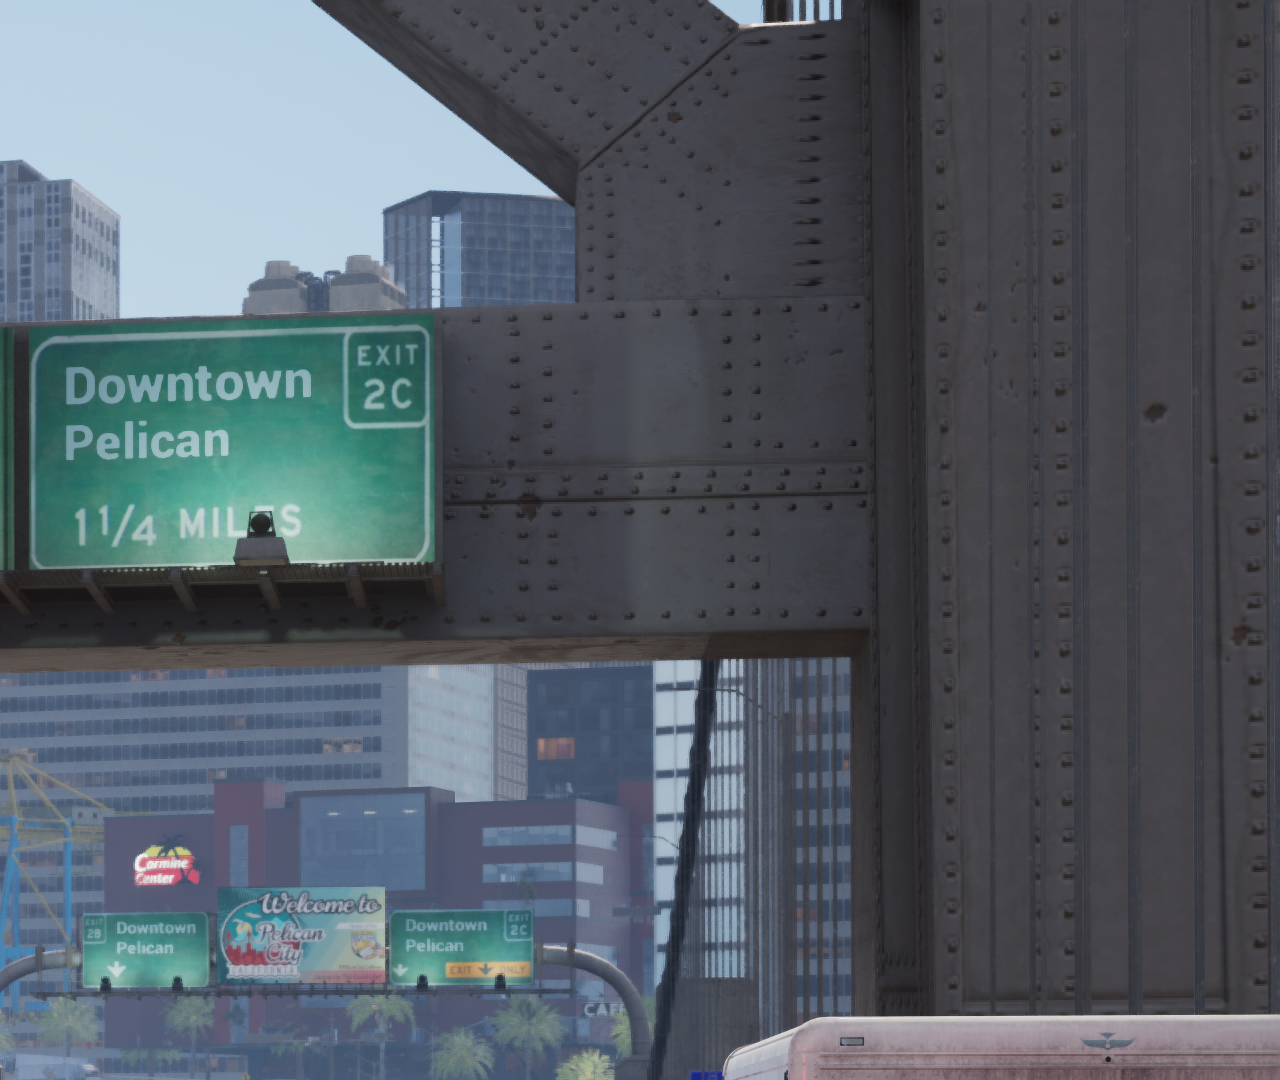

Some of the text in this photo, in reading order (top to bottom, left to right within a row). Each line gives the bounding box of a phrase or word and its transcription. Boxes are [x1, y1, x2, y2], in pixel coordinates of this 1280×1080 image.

[357, 344, 419, 367] EXIT
[65, 365, 312, 405] Downtown
[364, 378, 413, 410] 2C
[65, 421, 229, 461] Pelican
[180, 504, 302, 539] MILS
[258, 891, 382, 914] Welcome to
[85, 918, 104, 926] EXIT
[508, 914, 530, 922] EXIT
[116, 921, 196, 934] Downtown
[255, 921, 327, 943] Pelican
[405, 919, 488, 932] Downtown
[510, 925, 528, 936] 2C
[87, 928, 102, 939] 2B
[116, 941, 175, 955] Pelican
[405, 938, 464, 952] Pelican
[265, 943, 303, 965] City
[450, 966, 527, 975] EXIT ONLY
